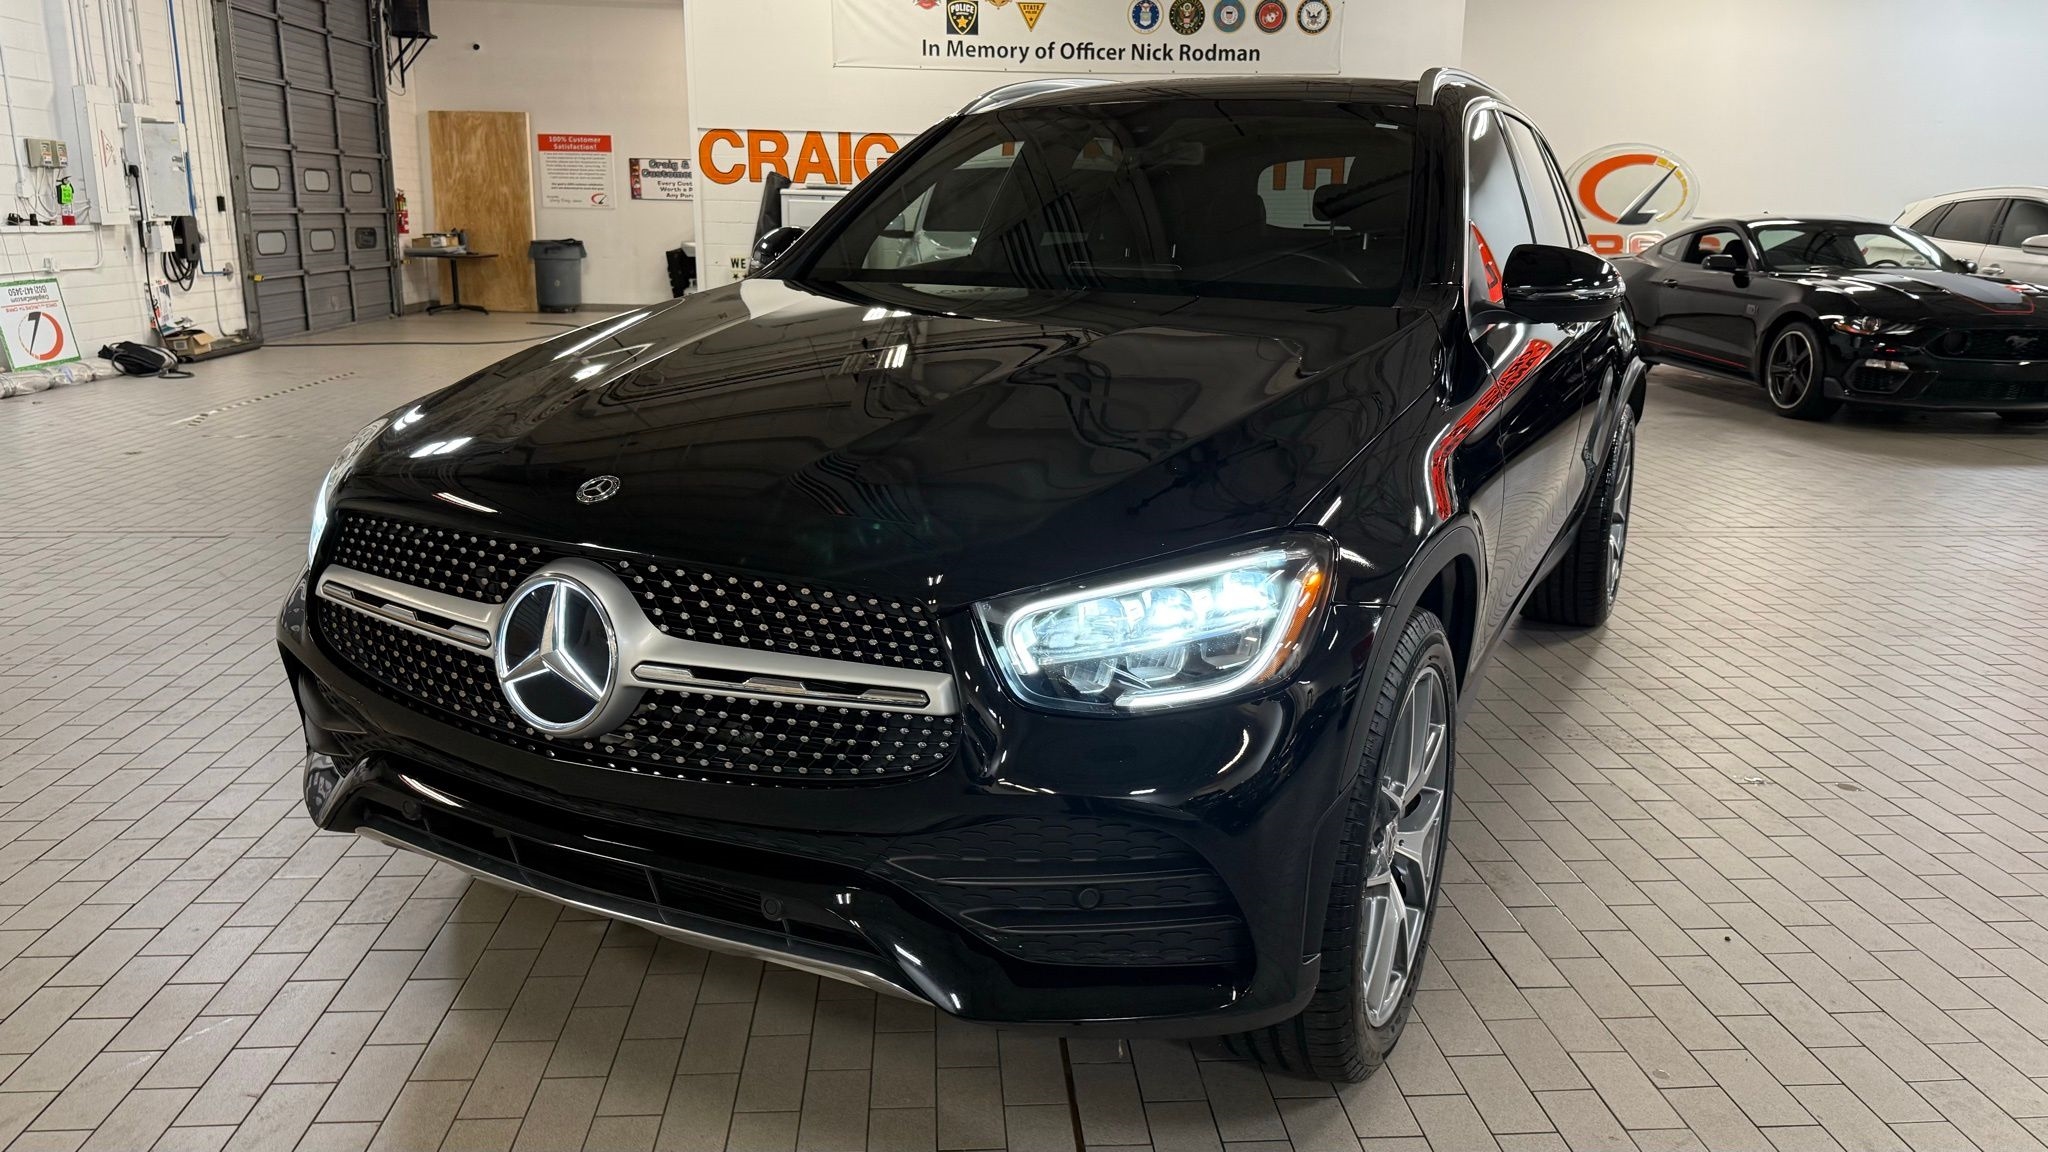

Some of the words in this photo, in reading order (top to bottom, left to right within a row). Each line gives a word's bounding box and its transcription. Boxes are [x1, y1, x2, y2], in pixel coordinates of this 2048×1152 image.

[951, 3, 975, 14] POLICE
[922, 39, 940, 56] In
[947, 39, 1029, 63] Memory
[1035, 41, 1056, 59] of
[1060, 41, 1126, 60] Officer
[1131, 43, 1174, 61] Nick
[1180, 43, 1260, 61] Rodman
[698, 128, 900, 185] CRAIG
[649, 159, 679, 171] Craig
[730, 257, 746, 269] WE
